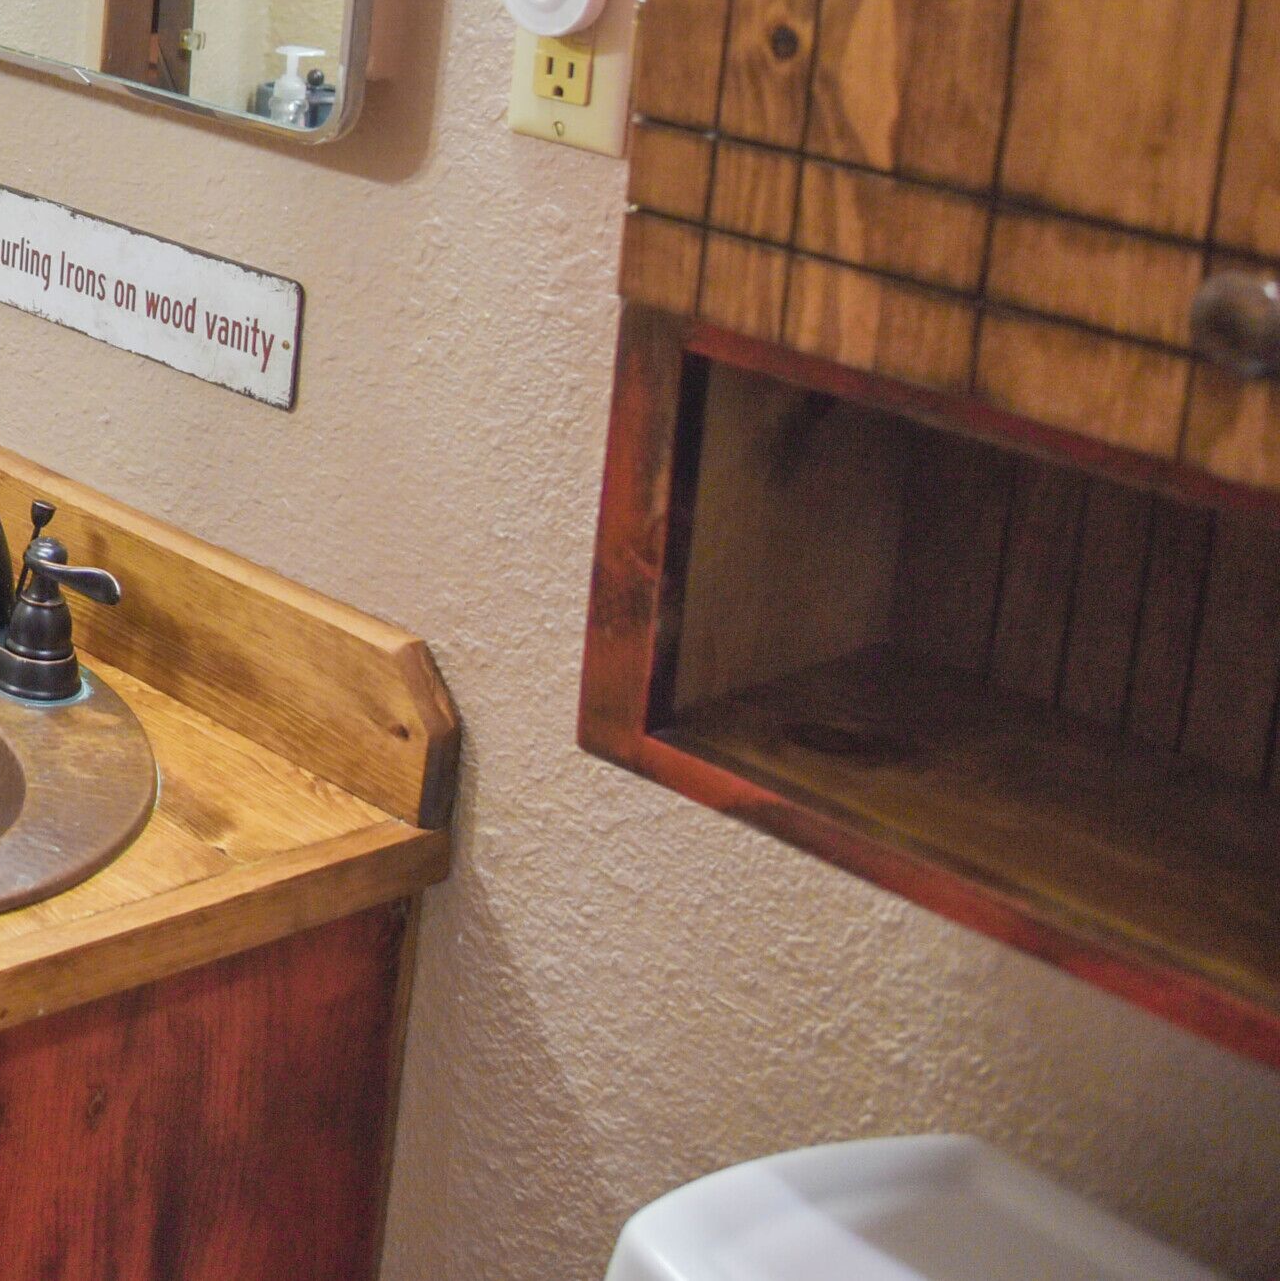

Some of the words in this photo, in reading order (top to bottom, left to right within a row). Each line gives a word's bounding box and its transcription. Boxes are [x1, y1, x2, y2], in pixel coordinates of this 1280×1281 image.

[59, 250, 107, 301] Irons
[114, 279, 137, 312] on
[145, 289, 197, 334] wood
[205, 310, 275, 374] vanity
